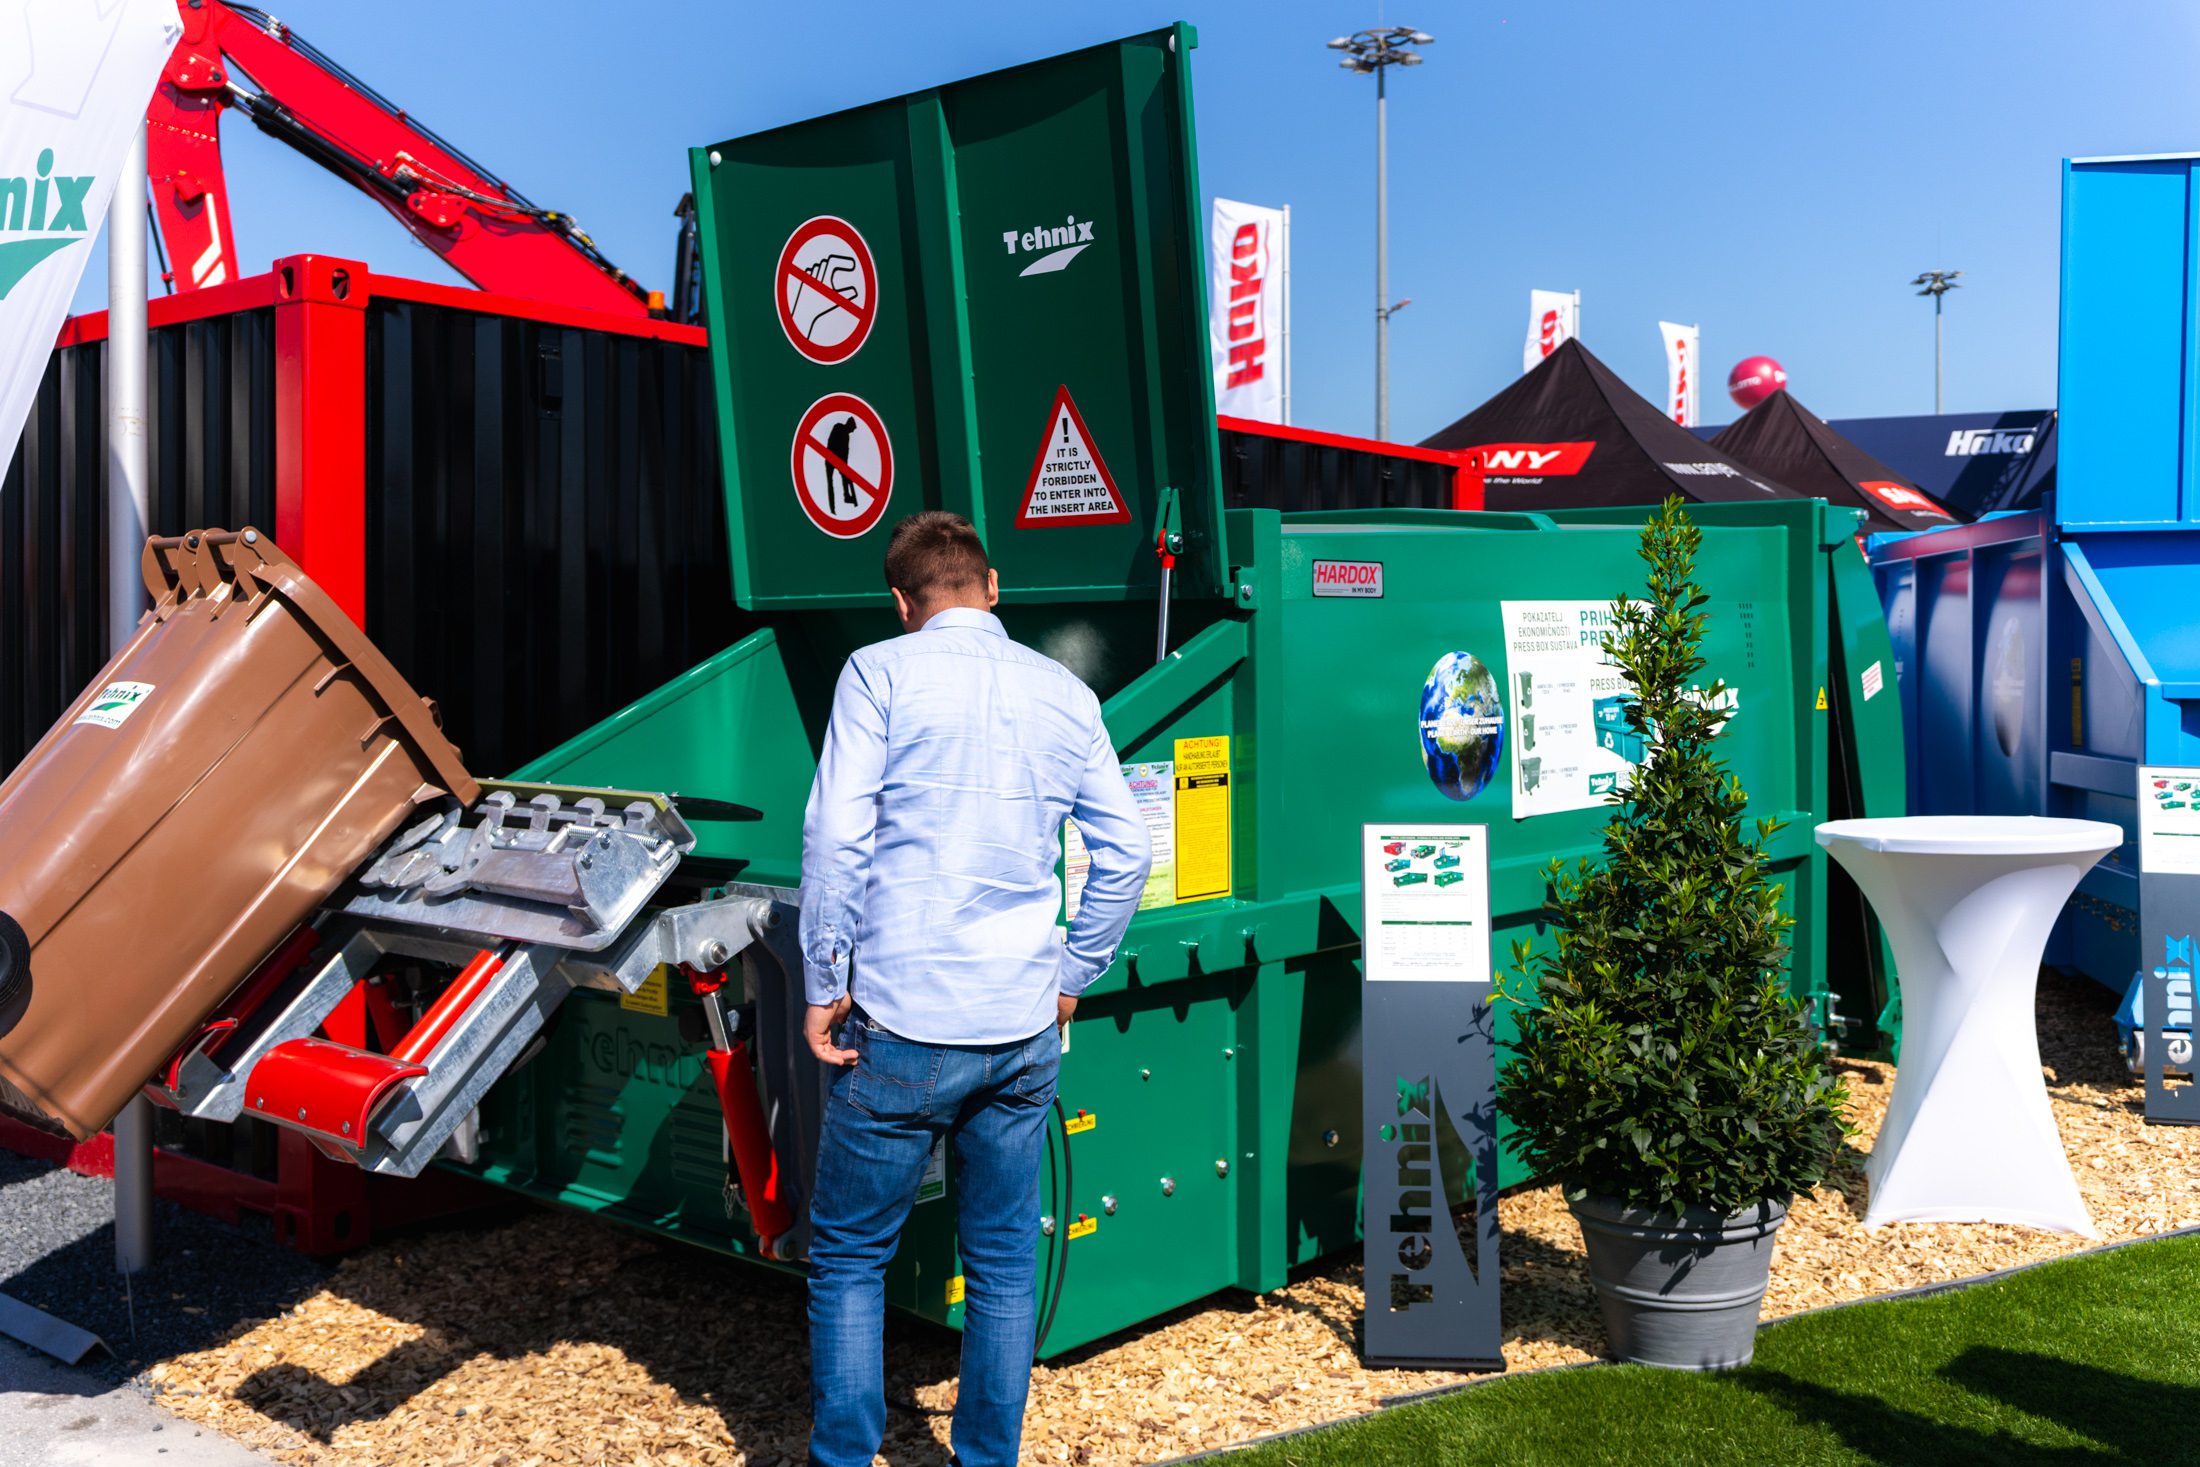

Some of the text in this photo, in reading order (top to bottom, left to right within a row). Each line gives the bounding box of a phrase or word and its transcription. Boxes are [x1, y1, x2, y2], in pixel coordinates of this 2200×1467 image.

[0, 147, 96, 232] nix
[1002, 214, 1095, 255] Tehnix
[1944, 427, 2038, 457] Hako
[1056, 447, 1078, 458] IT IS
[1483, 450, 1562, 469] NY
[1045, 460, 1091, 473] STRICTLY
[1042, 474, 1097, 487] FORBIDDEN
[1034, 487, 1107, 501] TO ENTER INTO
[1029, 501, 1114, 515] THE INSERT AREA
[1316, 564, 1378, 585] HARDOX
[1522, 611, 1563, 623] POKAZATELJ
[1518, 624, 1571, 638] EKONOMIČNOSTI
[1513, 640, 1578, 653] PRESS BOX SUSTAVA
[1590, 678, 1616, 691] PRESS
[1183, 738, 1222, 750] ACHTUNG!
[2153, 934, 2194, 1090] Tehnix
[1379, 1073, 1433, 1312] Tehnix
